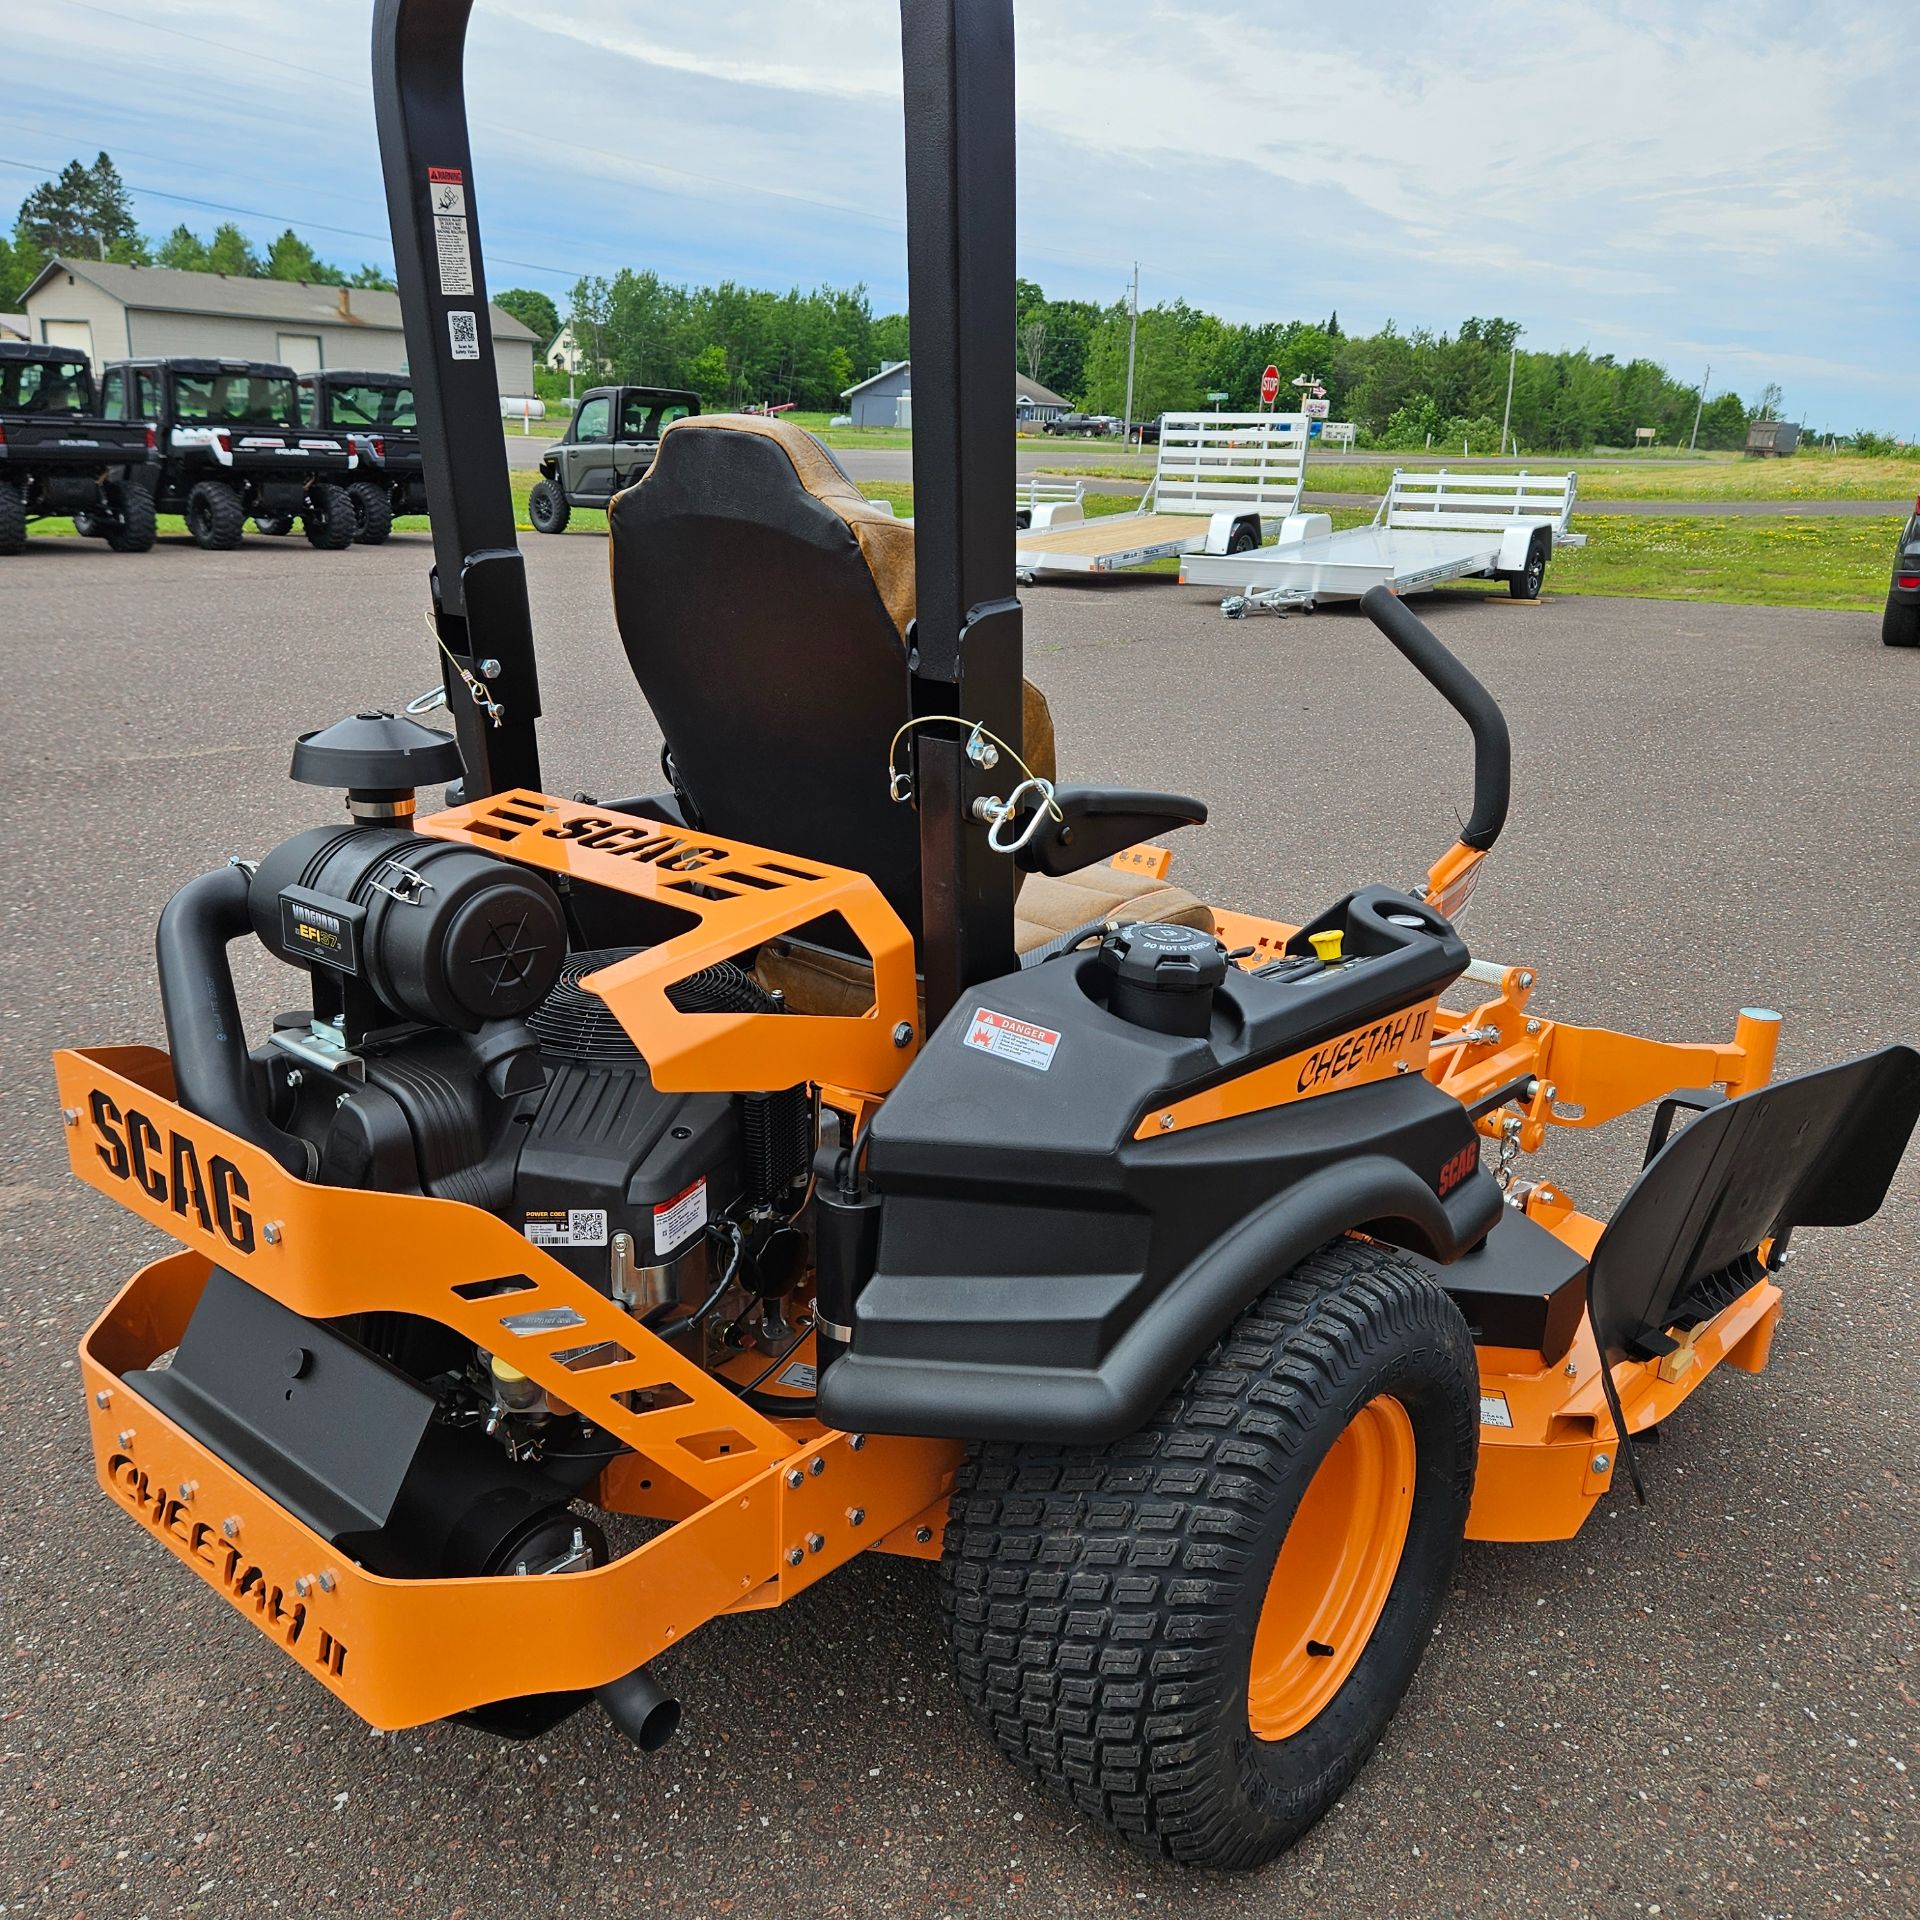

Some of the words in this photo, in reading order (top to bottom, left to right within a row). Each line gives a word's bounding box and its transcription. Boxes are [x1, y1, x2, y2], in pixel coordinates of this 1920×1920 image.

[1262, 377, 1279, 391] STOP
[542, 817, 730, 872] SCAG
[292, 904, 340, 934] VANGUARD
[1001, 1020, 1046, 1041] DANGER
[1296, 1012, 1413, 1093] CHEETAH
[1410, 1010, 1429, 1043] II
[88, 1088, 256, 1257] SCAG
[1438, 1141, 1476, 1197] SCAG
[108, 1454, 306, 1650] CHEETAH
[316, 1626, 348, 1678] II
